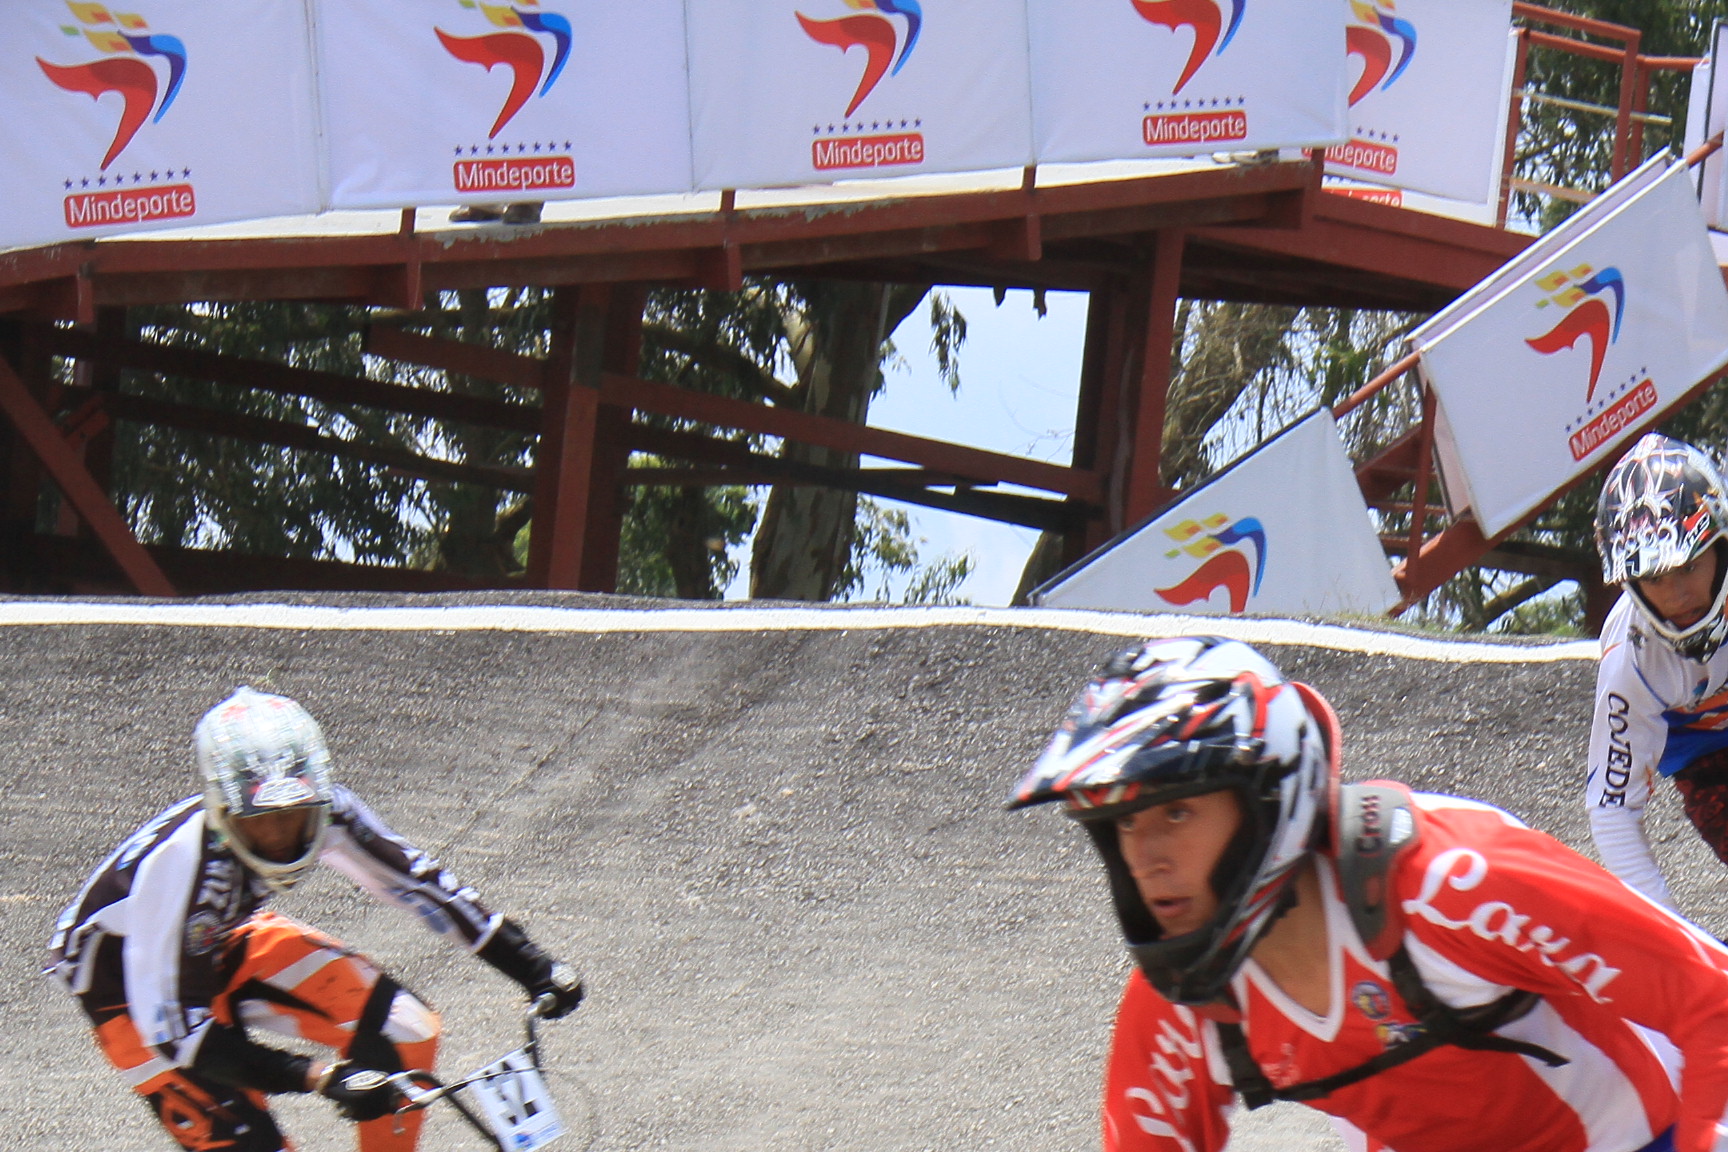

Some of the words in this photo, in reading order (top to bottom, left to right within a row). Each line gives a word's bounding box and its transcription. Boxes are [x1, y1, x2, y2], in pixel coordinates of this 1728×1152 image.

[1146, 116, 1246, 141] Mindeporte
[816, 139, 923, 167] Mindeporte
[1304, 143, 1396, 172] ndeporte
[458, 162, 574, 190] Mindeporte
[69, 191, 194, 223] Mindeporte
[1573, 382, 1656, 458] Mindeporte
